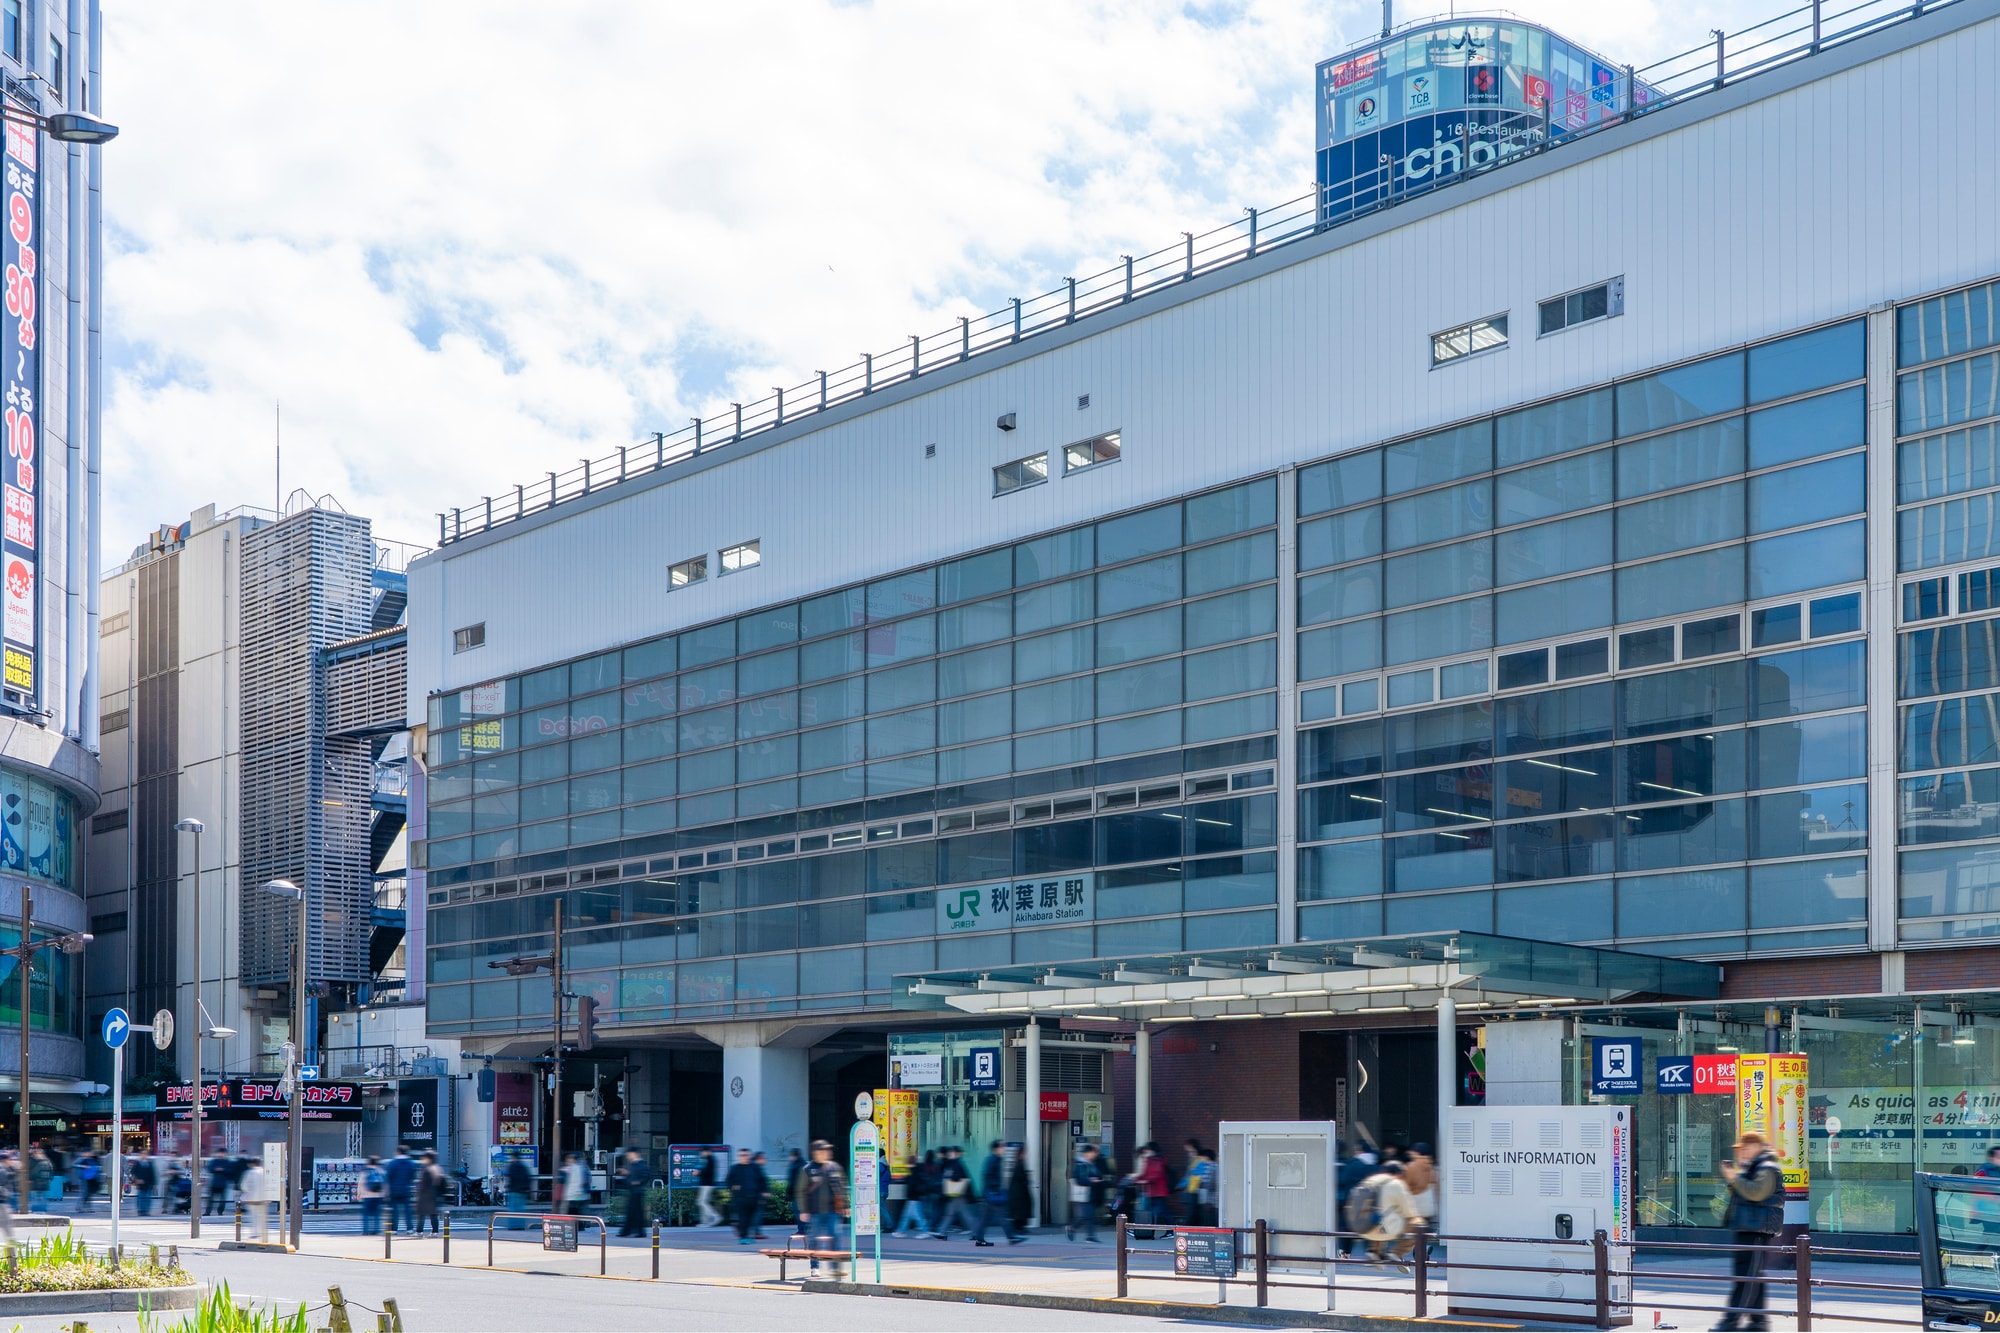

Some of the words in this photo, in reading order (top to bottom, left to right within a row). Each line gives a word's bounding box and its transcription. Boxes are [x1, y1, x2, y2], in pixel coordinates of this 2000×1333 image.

[1411, 92, 1430, 105] TCB
[5, 380, 34, 413] よる
[6, 613, 32, 633] Tax-free
[10, 627, 27, 643] Shop
[5, 648, 32, 672] 免税品
[5, 665, 32, 689] 取扱店
[946, 889, 981, 919] JR
[991, 878, 1084, 914] 秋葉原駅
[1015, 911, 1053, 923] Akihabara
[1055, 908, 1084, 920] Station
[950, 919, 976, 930] JR東日本
[1659, 1064, 1691, 1082] TX
[1778, 1060, 1809, 1073] 生の風
[1695, 1067, 1713, 1083] 01
[1597, 1080, 1610, 1089] TX
[1848, 1093, 1870, 1109] As
[1876, 1093, 1915, 1113] quic
[1928, 1096, 1949, 1108] as
[1953, 1090, 1968, 1109] 4
[501, 1106, 522, 1117] atré
[523, 1107, 529, 1117] 2
[1880, 1141, 1902, 1150] 北千住
[1942, 1141, 1957, 1150] 六町
[1460, 1151, 1500, 1165] Tourist
[1503, 1151, 1597, 1165] INFORMATION
